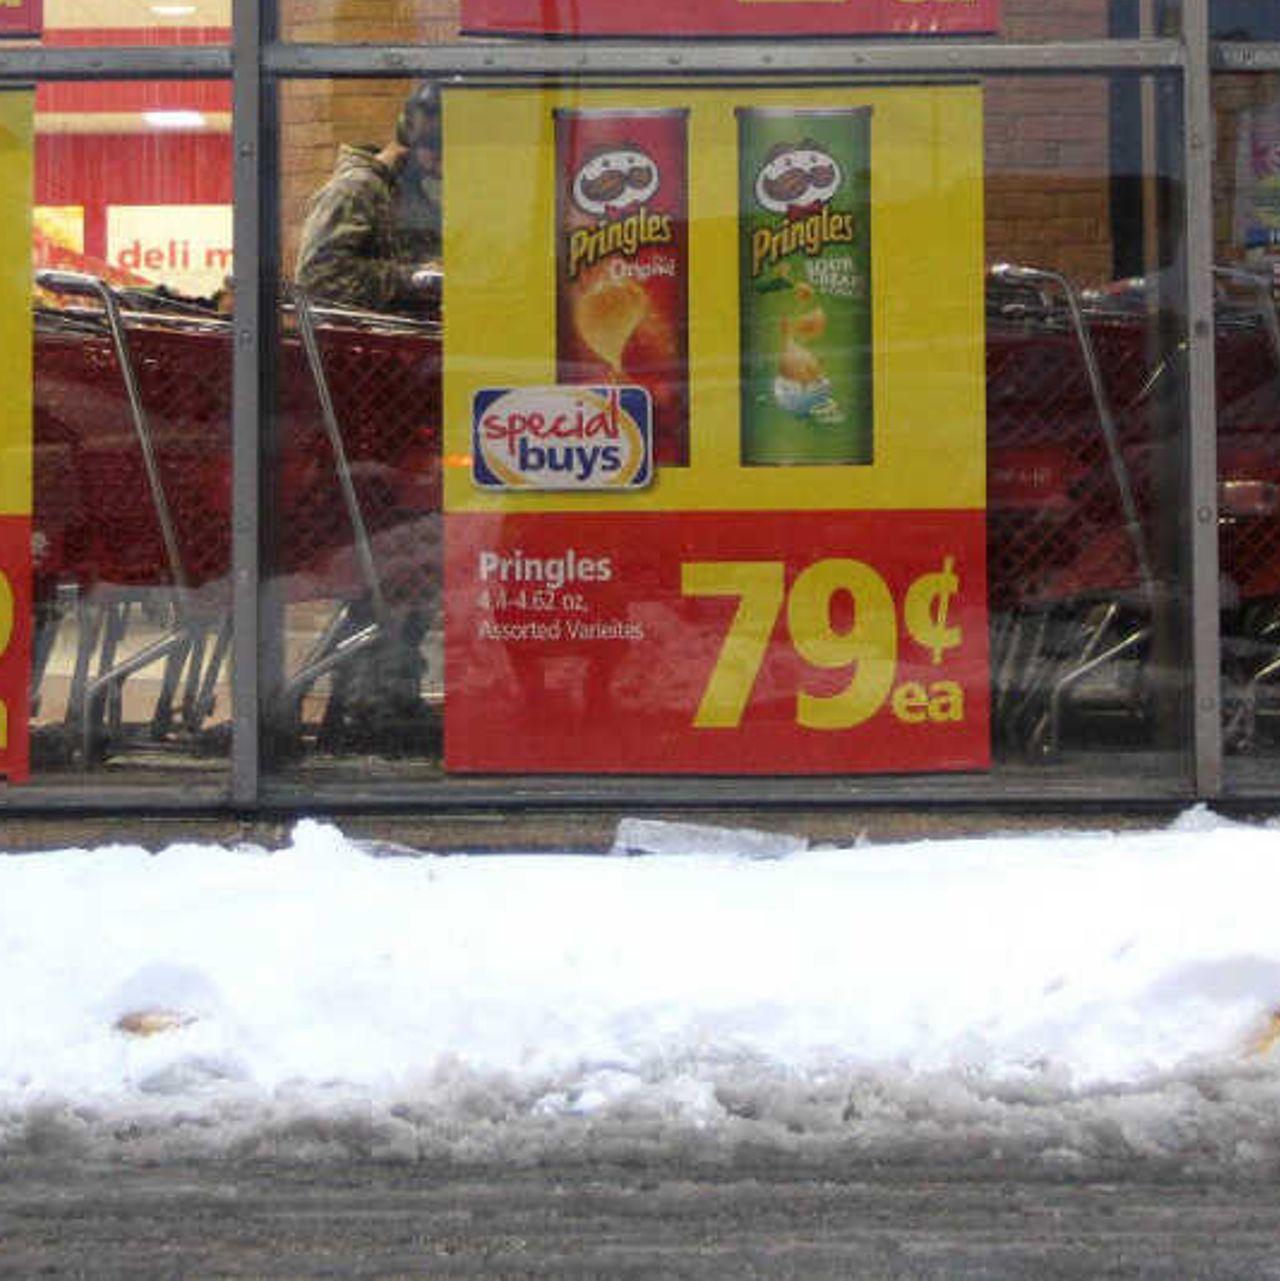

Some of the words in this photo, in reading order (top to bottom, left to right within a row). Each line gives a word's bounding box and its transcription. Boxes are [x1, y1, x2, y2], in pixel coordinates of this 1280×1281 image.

[117, 238, 190, 270] deli
[570, 205, 673, 278] Pringles
[752, 205, 855, 278] Pringles
[483, 389, 620, 457] special
[519, 436, 622, 481] buys
[478, 548, 613, 590] Pringles
[478, 620, 561, 641] Assorted
[567, 620, 645, 641] Varieties
[891, 678, 965, 725] ea
